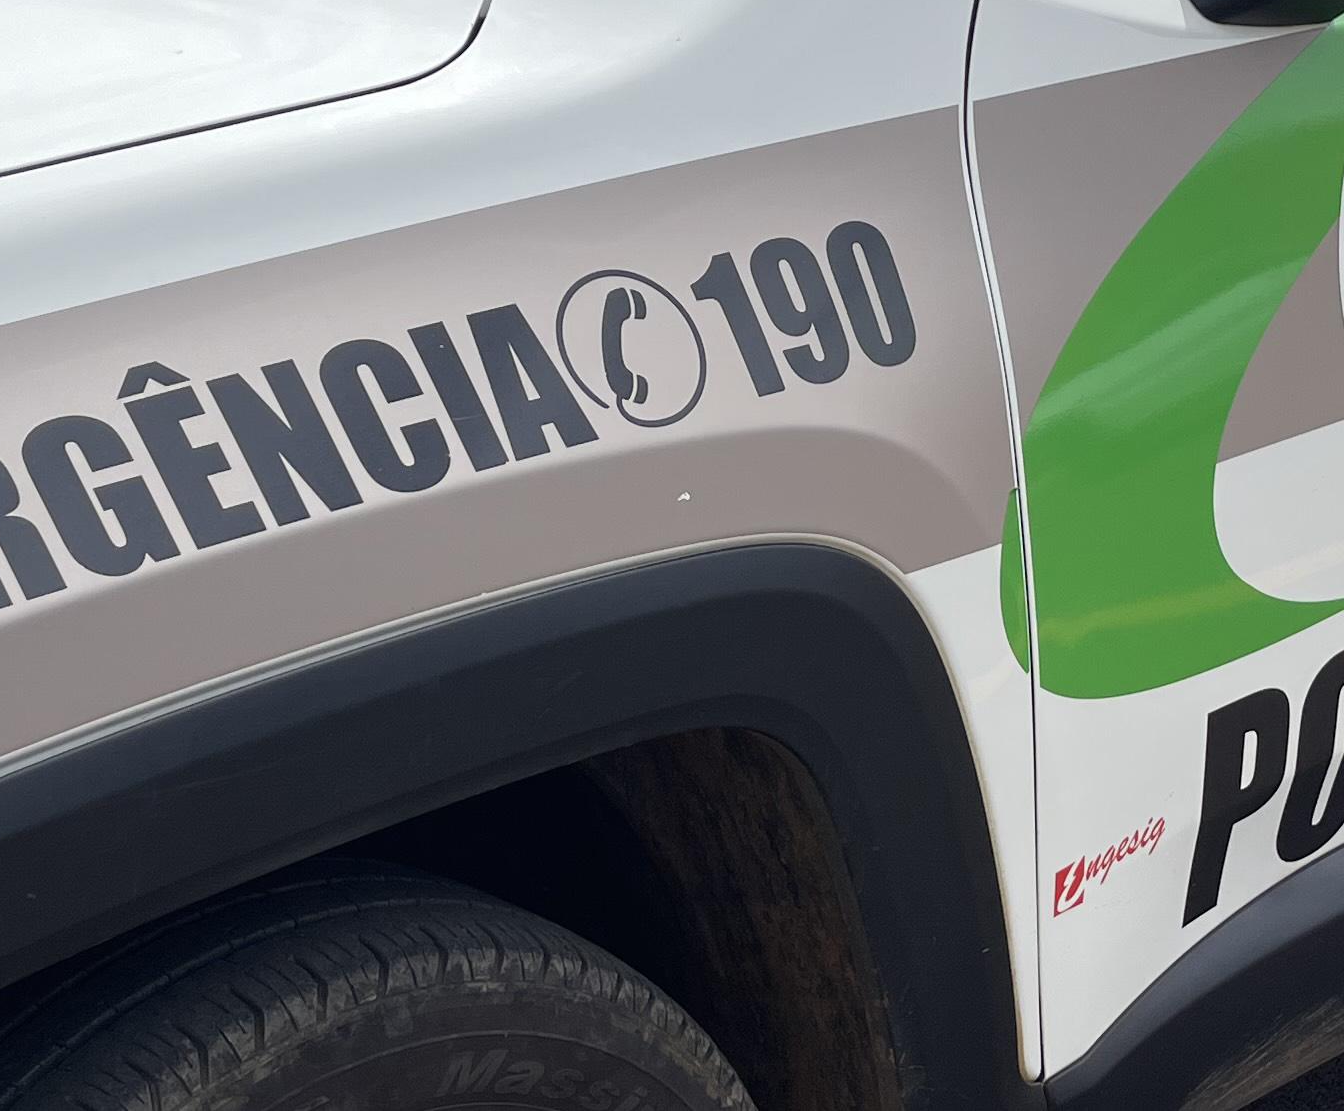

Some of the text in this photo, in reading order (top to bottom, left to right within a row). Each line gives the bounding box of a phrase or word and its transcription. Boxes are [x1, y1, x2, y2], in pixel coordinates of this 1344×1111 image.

[689, 220, 918, 398] 190
[1053, 816, 1166, 918] Engesig
[436, 1048, 662, 1111] Massi
